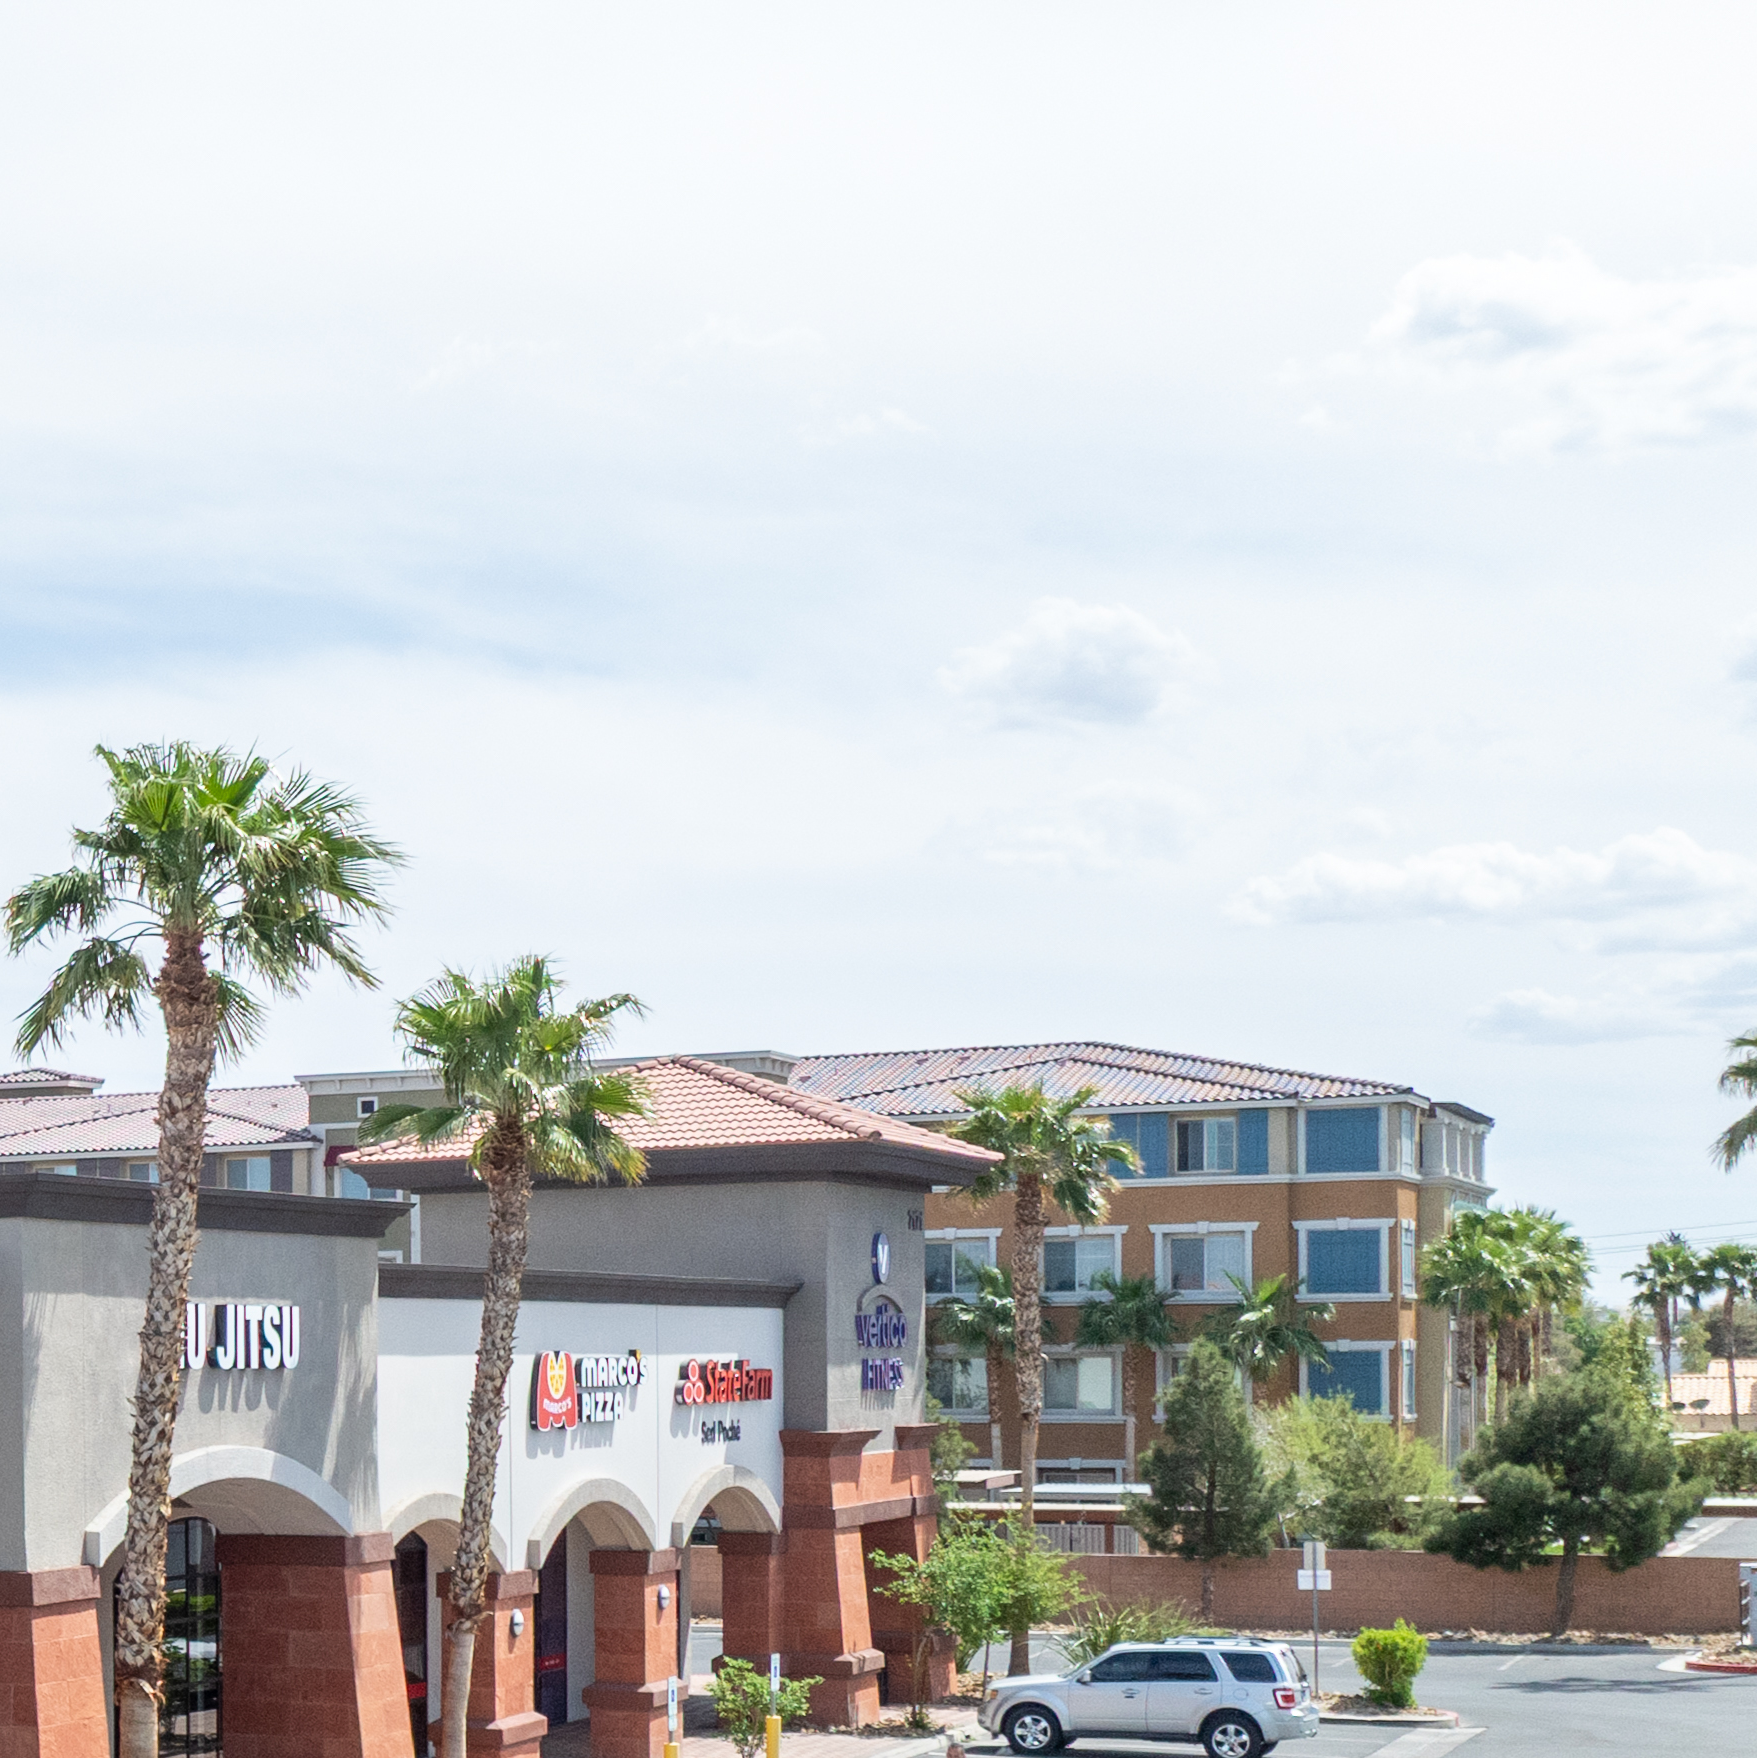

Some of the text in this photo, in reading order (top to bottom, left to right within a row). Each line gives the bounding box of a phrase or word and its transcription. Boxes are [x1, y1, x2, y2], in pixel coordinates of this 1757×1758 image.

[216, 1304, 301, 1371] JITSU
[581, 1349, 648, 1387] MARCO'S
[582, 1391, 624, 1423] PIZZA
